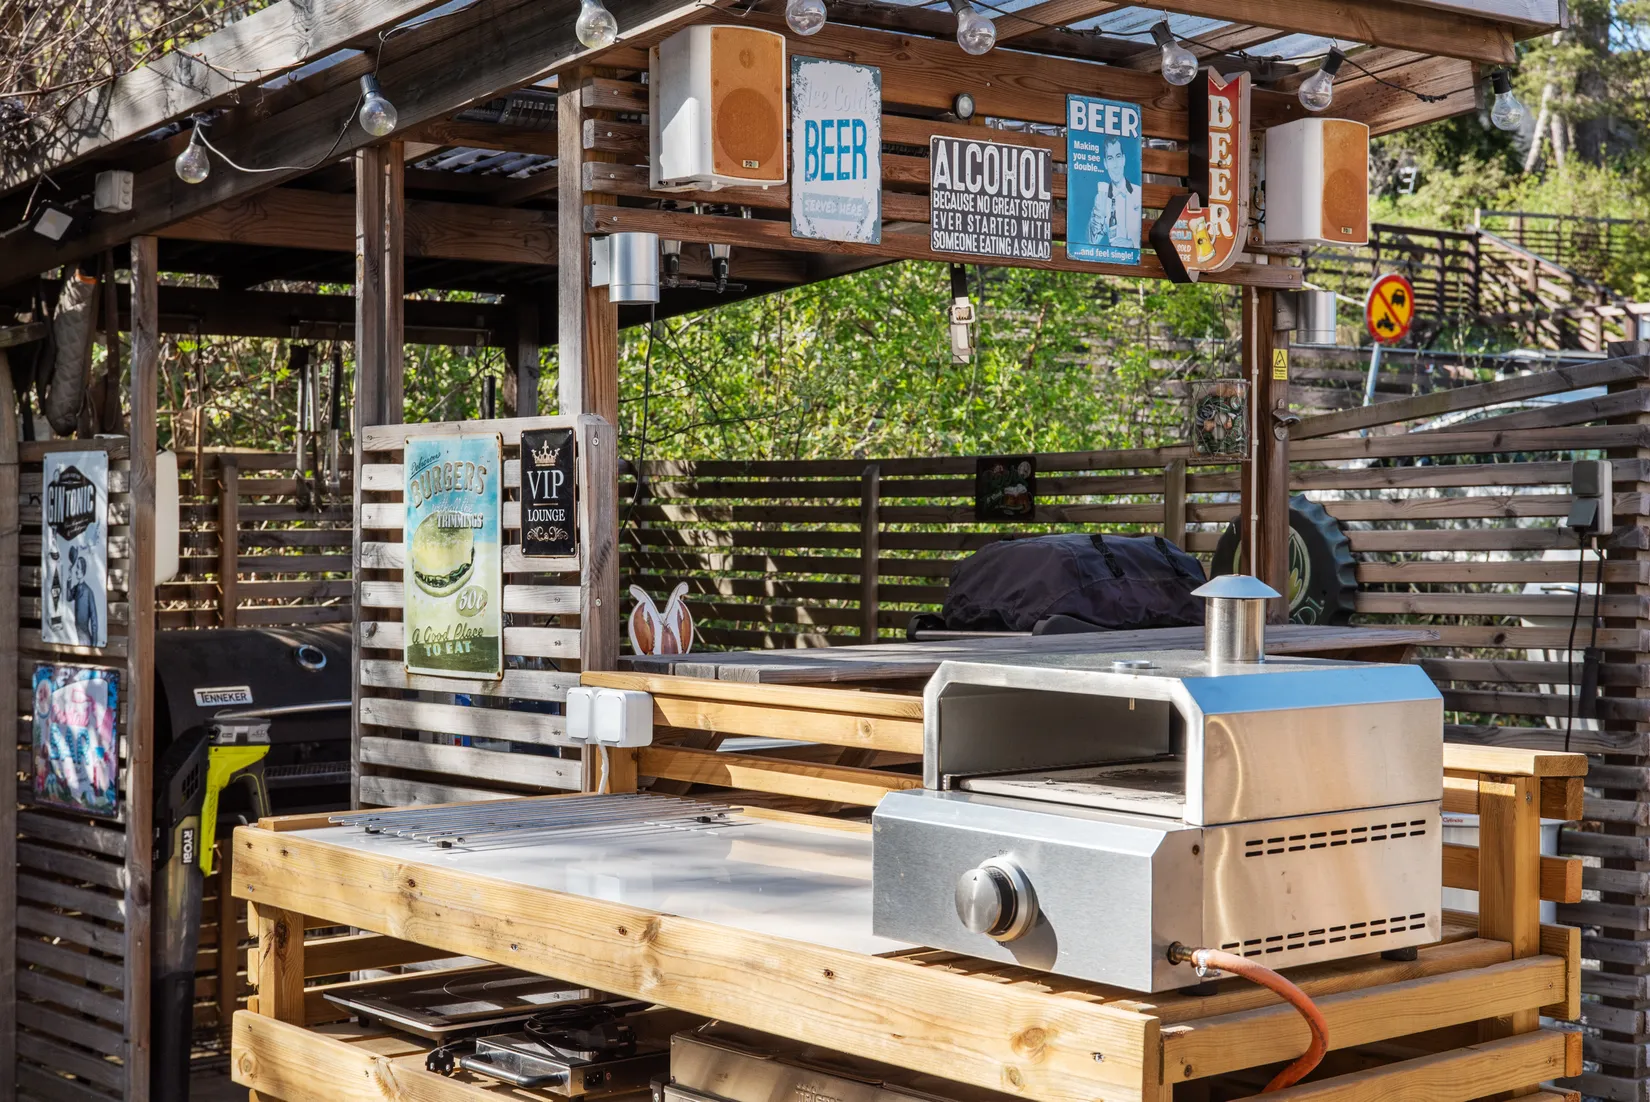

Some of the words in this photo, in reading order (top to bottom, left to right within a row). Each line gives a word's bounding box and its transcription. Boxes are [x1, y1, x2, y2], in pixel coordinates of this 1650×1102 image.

[1069, 99, 1139, 139] BEER
[804, 118, 868, 183] BEER
[1072, 152, 1086, 162] you
[1087, 154, 1101, 163] see
[1073, 140, 1100, 153] Making
[932, 140, 1051, 200] ALCOHOL
[1073, 161, 1105, 173] double...
[1208, 95, 1234, 238] BEER
[804, 199, 838, 214] SERVED
[840, 202, 865, 217] HERE
[933, 190, 975, 212] BECAUSE
[976, 195, 990, 214] NO
[992, 196, 1020, 217] GREAT
[1021, 199, 1051, 220] STORY
[933, 210, 963, 231] EVER
[967, 214, 1018, 237] STARTED
[1021, 219, 1051, 240] WITH
[933, 230, 978, 252] SOMEONE
[979, 235, 1012, 256] EATING
[1012, 238, 1020, 257] A
[1021, 239, 1051, 259] SALAD
[1095, 248, 1110, 258] feel
[1111, 249, 1134, 261] single!
[410, 461, 487, 509] BURGERS
[526, 469, 564, 499] VIP
[48, 485, 66, 524] GIN
[65, 484, 94, 518] TONIC
[527, 508, 566, 522] LOUNGE
[437, 512, 483, 529] TRIMMINGS
[424, 624, 451, 644] Good
[454, 622, 484, 640] Place
[424, 642, 441, 656] TO
[446, 640, 472, 654] EAT
[197, 690, 248, 704] TENNEKER
[183, 829, 194, 864] RYOBI
